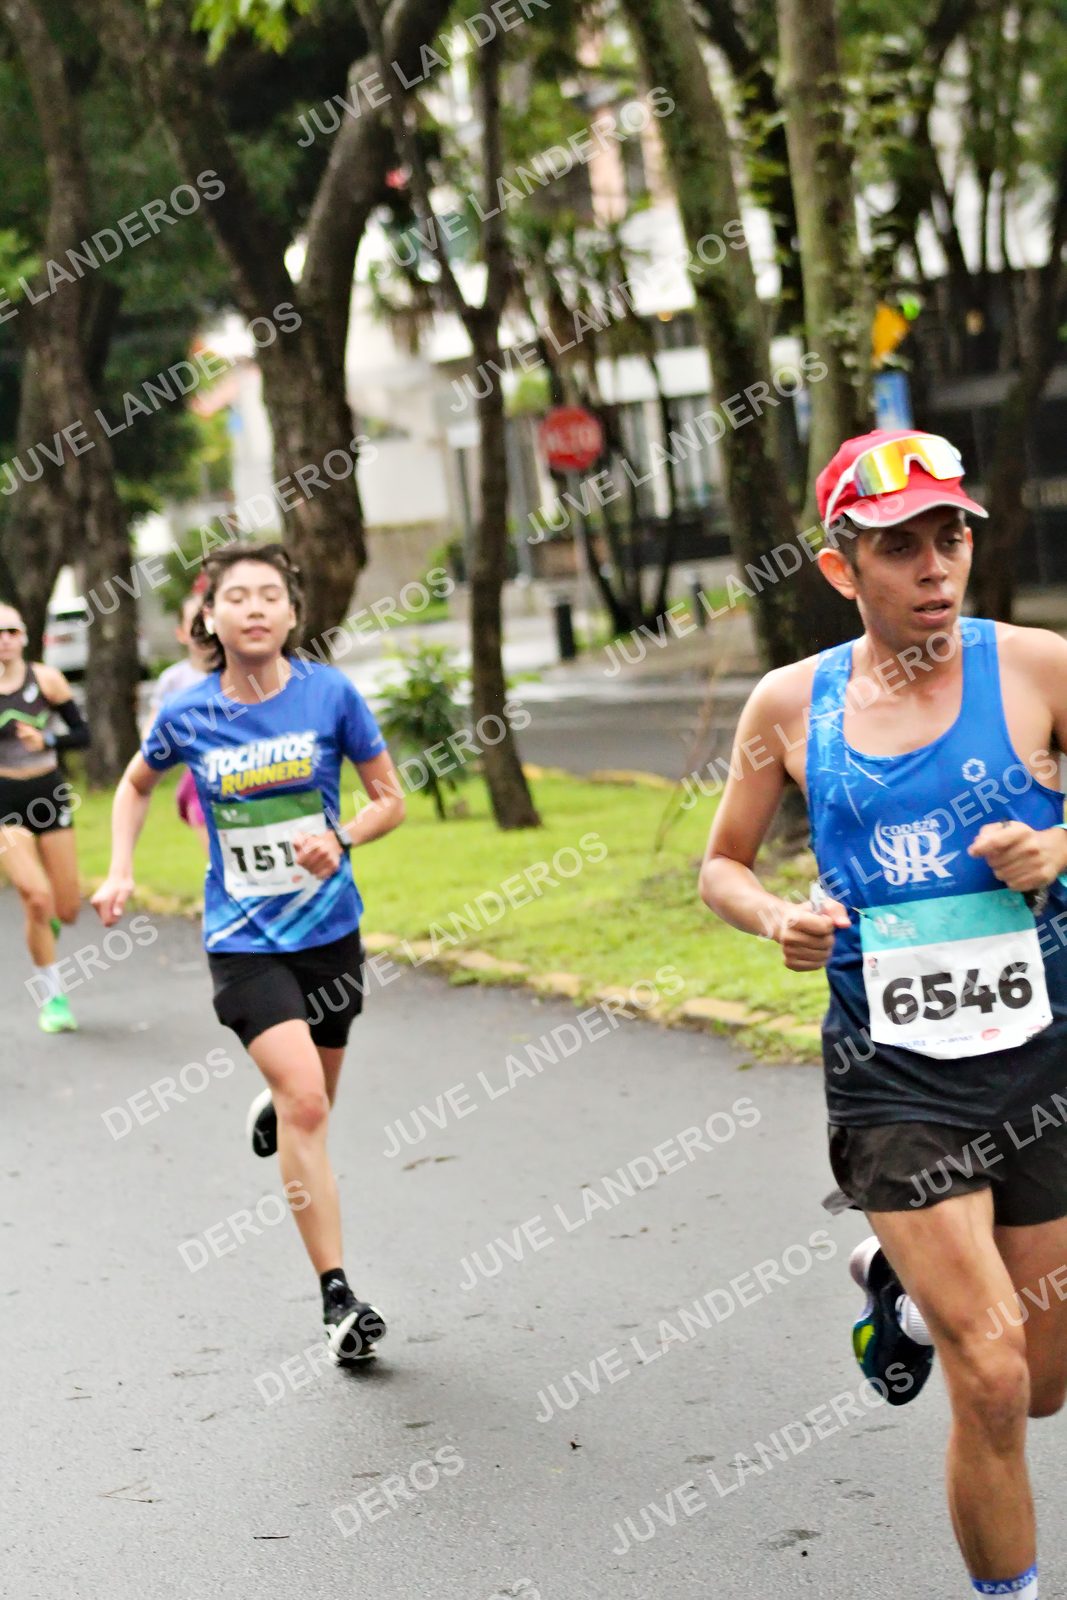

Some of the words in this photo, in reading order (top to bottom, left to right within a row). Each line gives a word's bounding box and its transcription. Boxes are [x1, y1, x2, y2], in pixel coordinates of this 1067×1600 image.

[204, 731, 319, 782] TOCHITOS
[221, 757, 312, 796] RUNNERS
[231, 840, 295, 873] 151
[882, 961, 1033, 1026] 6546
